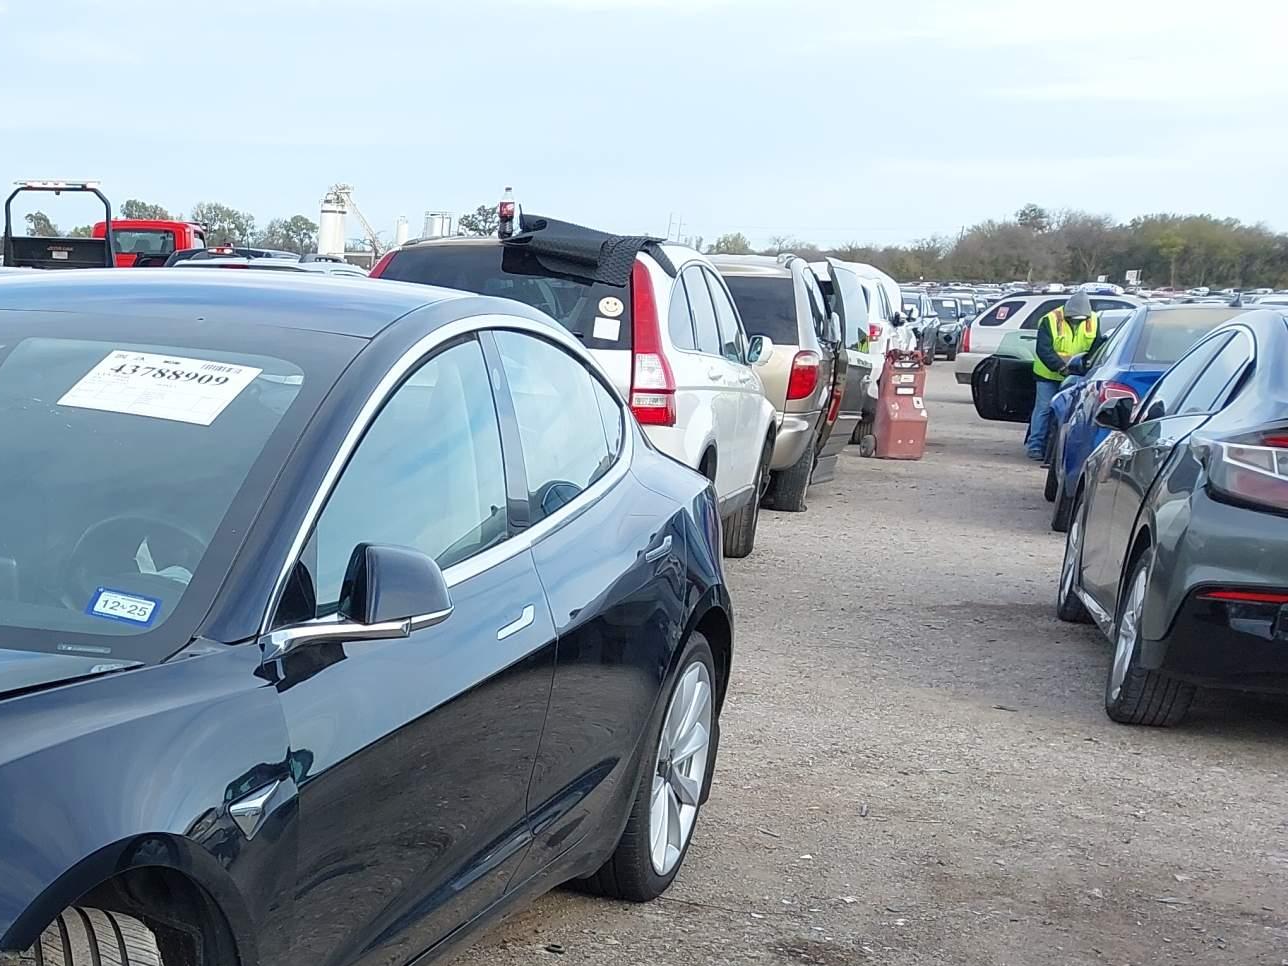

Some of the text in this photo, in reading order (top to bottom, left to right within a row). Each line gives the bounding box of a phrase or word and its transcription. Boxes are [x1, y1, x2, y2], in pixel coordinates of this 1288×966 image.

[110, 363, 230, 386] 43788909
[102, 599, 121, 611] 12
[127, 604, 149, 617] 25
